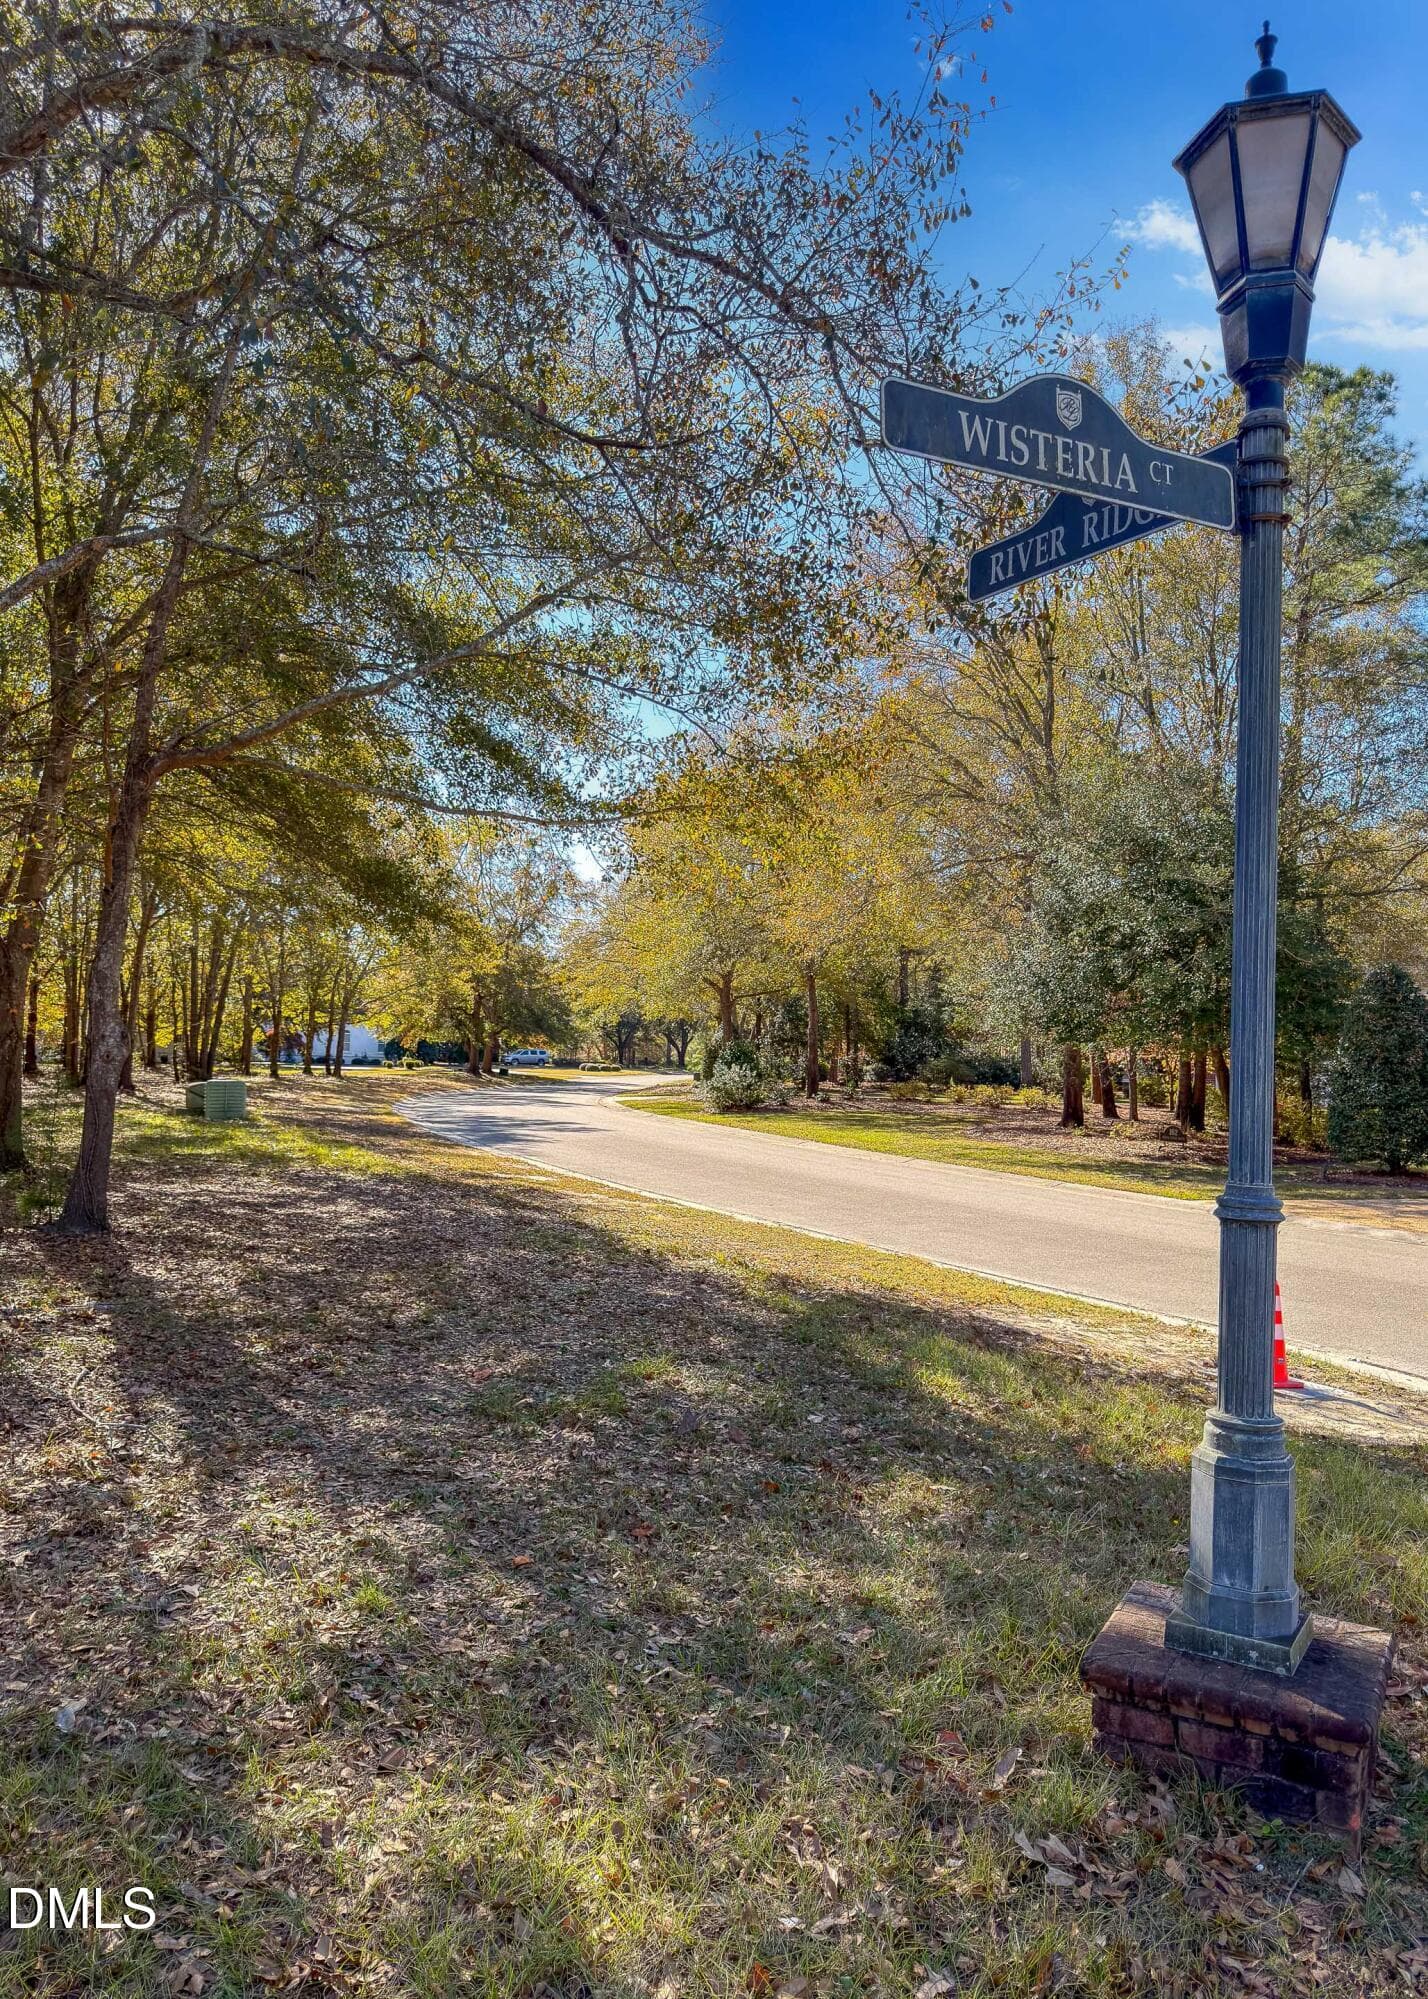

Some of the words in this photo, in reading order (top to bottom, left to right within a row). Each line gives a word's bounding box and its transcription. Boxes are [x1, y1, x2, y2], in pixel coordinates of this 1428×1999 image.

[958, 410, 1138, 493] WISTERIA
[1150, 461, 1174, 485] CT
[989, 526, 1067, 585] RIVER
[1081, 504, 1161, 548] RID
